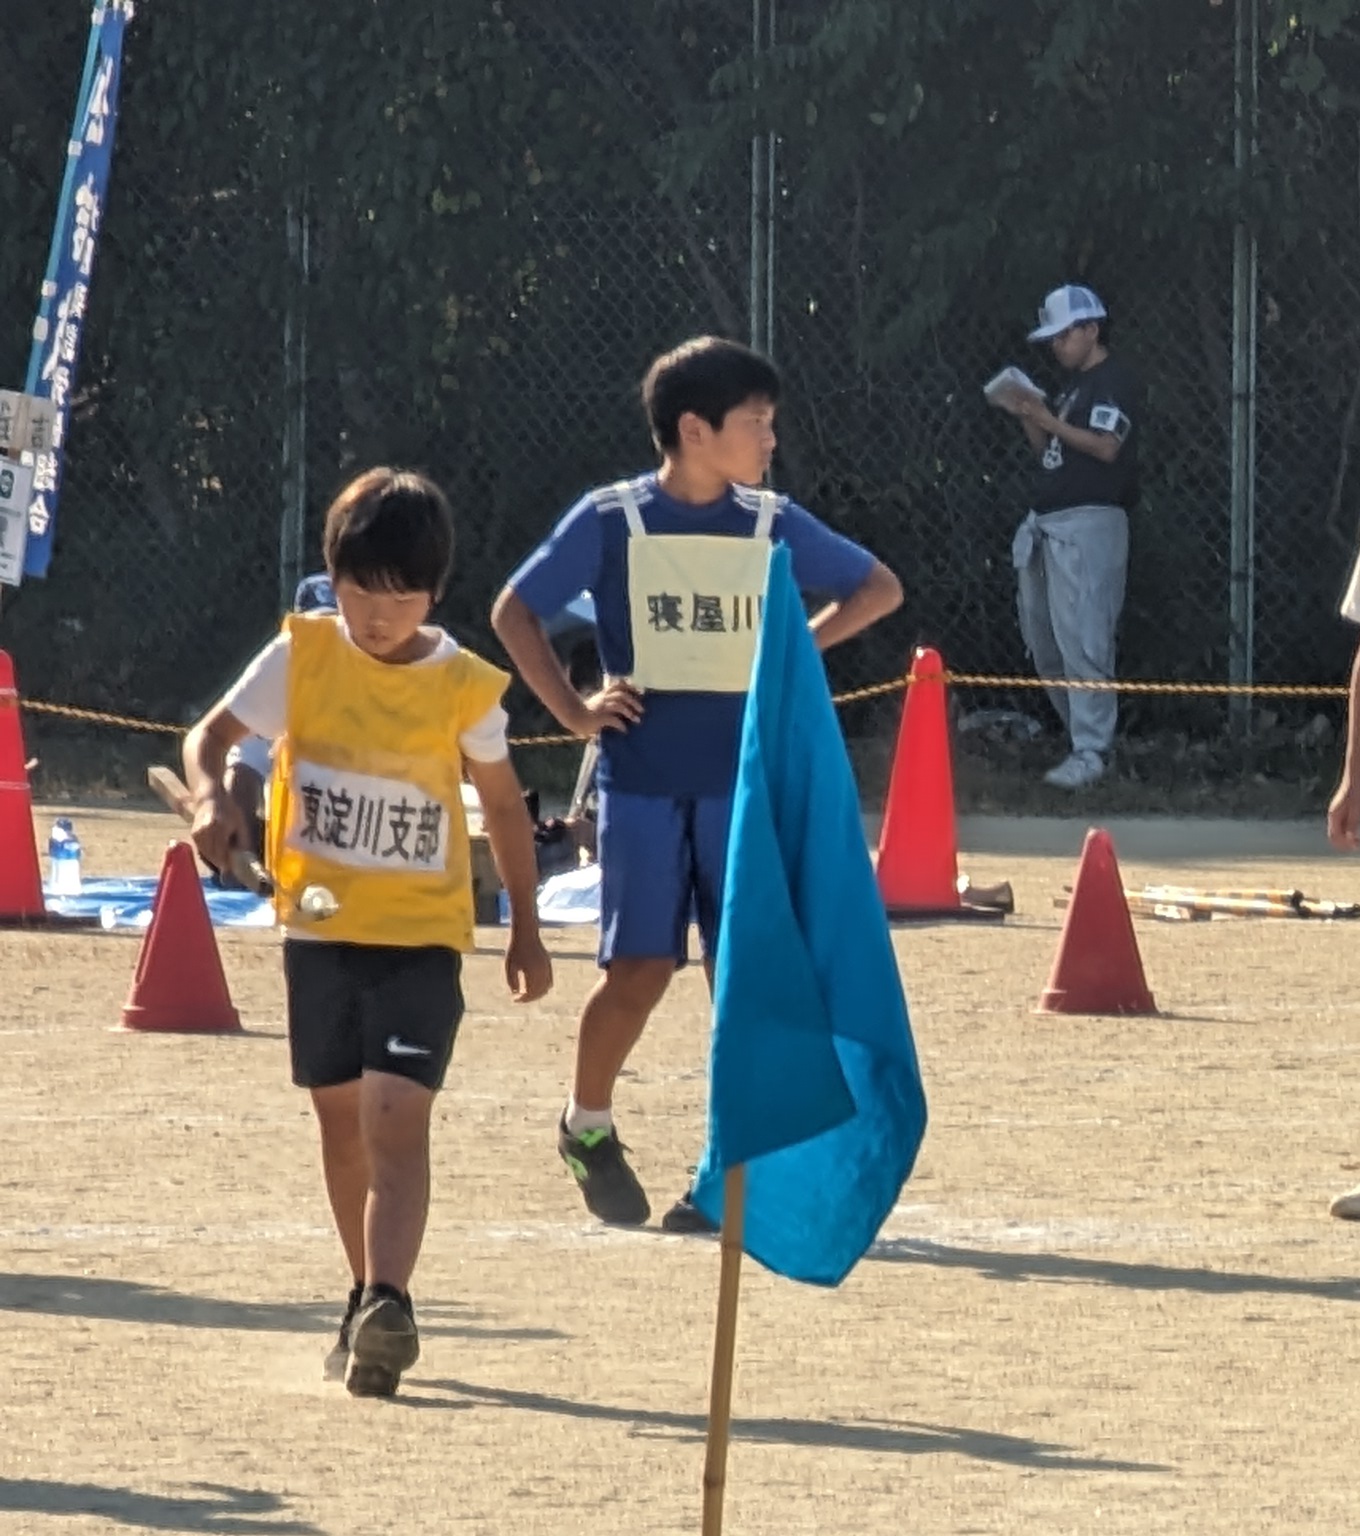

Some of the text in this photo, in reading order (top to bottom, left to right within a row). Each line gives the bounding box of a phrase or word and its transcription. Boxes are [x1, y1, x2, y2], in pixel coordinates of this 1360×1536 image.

[646, 592, 763, 632] 寝屋川
[300, 780, 442, 863] 東淀川支部
